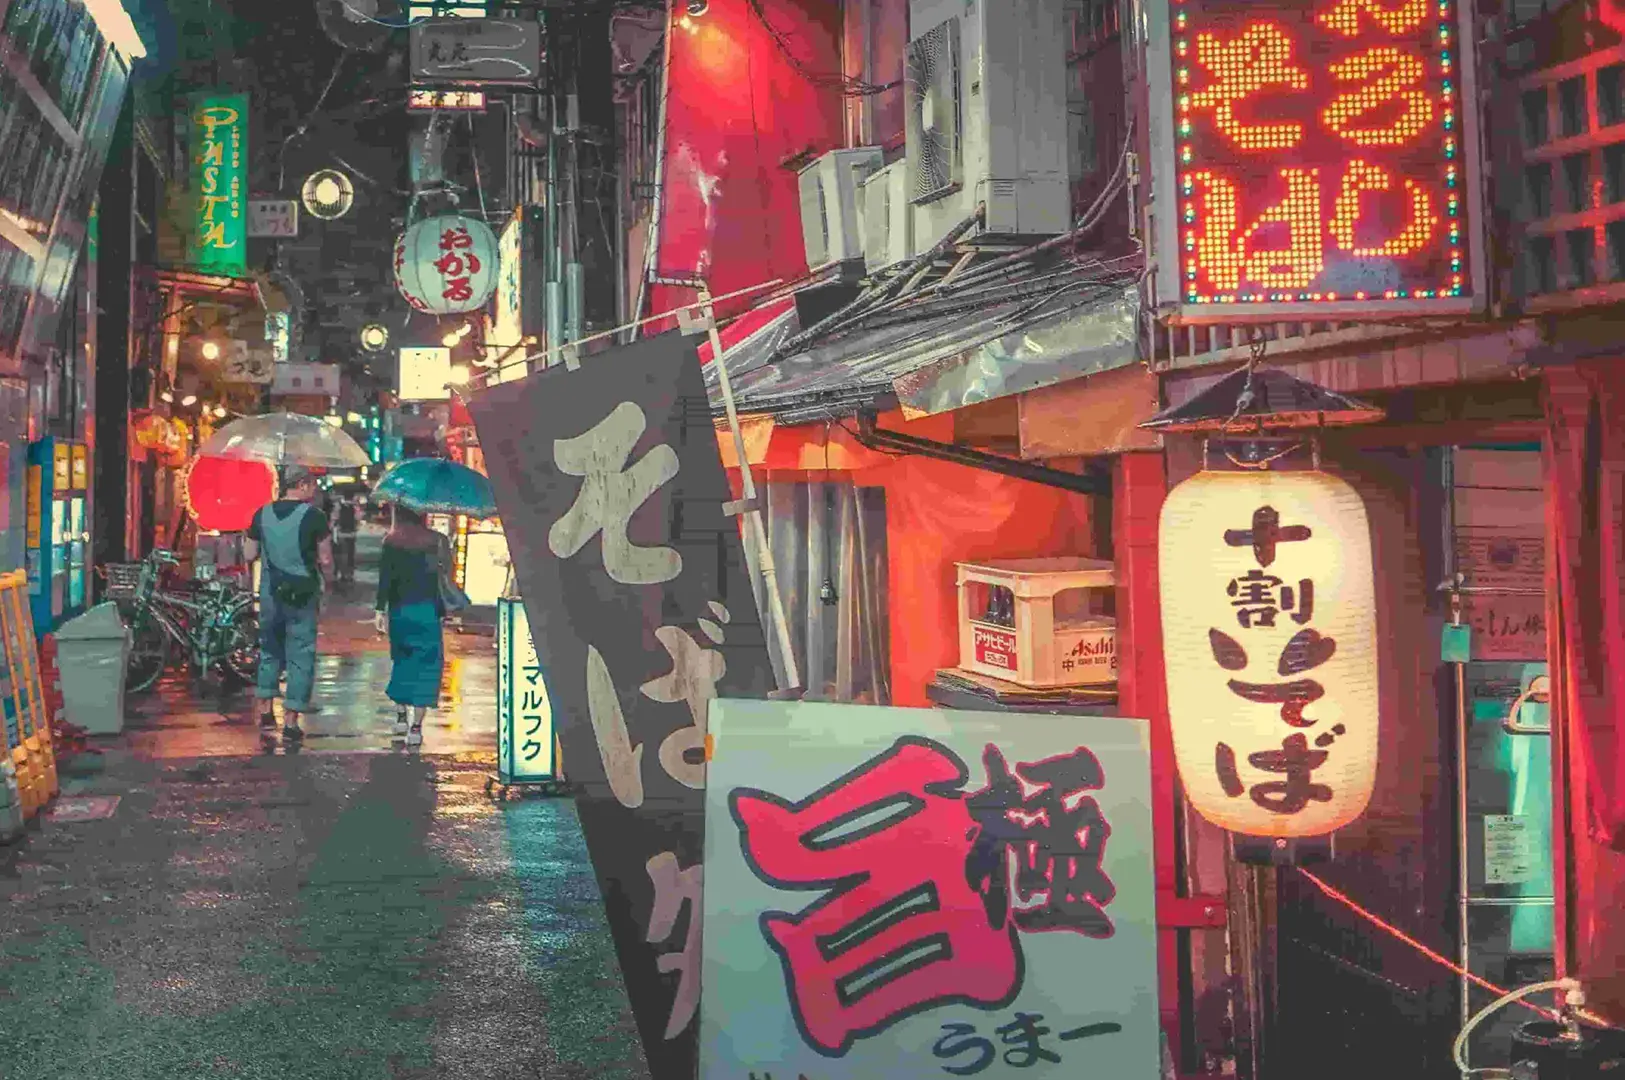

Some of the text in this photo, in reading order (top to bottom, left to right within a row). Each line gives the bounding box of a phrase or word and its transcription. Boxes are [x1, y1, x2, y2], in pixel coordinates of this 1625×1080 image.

[194, 106, 239, 249] PASTA
[433, 228, 481, 302] おかる
[975, 630, 1017, 655] アサヒビール
[1071, 635, 1114, 657] Asahi
[1207, 504, 1347, 815] 十割そば
[521, 665, 543, 761] マルフク
[727, 734, 1027, 1059] 旨
